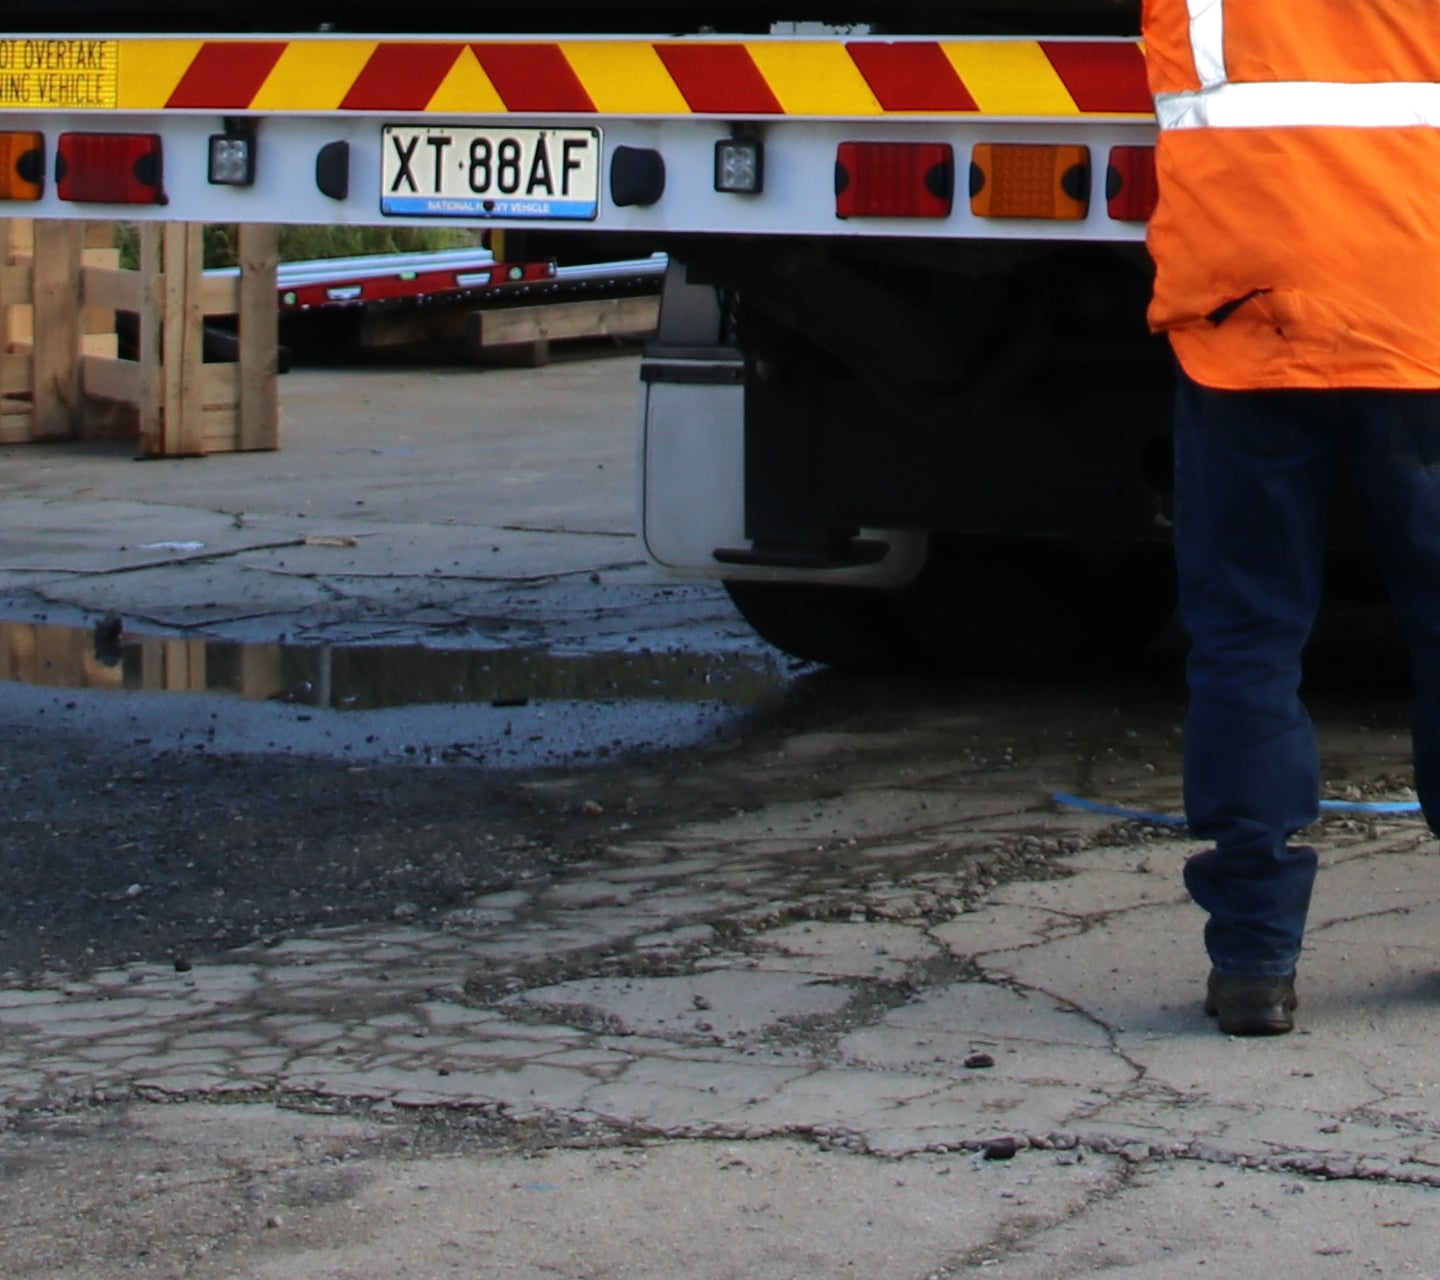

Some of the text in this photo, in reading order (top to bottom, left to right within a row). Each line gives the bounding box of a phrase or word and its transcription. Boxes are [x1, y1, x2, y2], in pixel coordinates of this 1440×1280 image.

[24, 40, 107, 70] OVERTAKE
[37, 73, 106, 103] VEHICLE
[391, 135, 589, 196] XT 88AF
[427, 200, 551, 213] NATIONAL HVY VEHICLE
